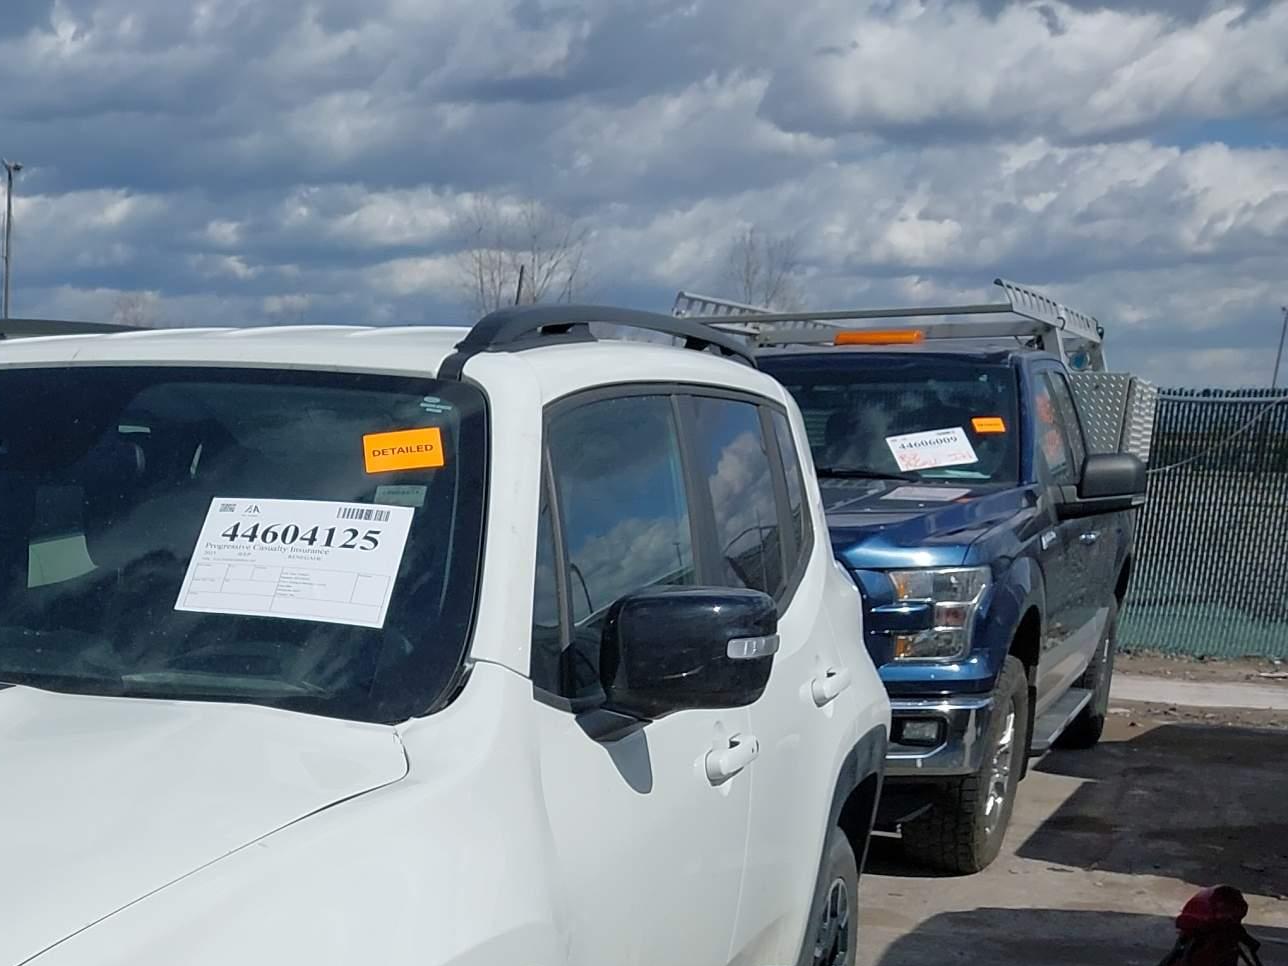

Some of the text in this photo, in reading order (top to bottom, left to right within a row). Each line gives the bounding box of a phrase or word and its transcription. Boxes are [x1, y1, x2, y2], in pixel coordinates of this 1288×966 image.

[372, 444, 434, 457] DETAILED
[221, 521, 382, 551] 44604125
[205, 542, 330, 555] Progressive Casualty Insurance
